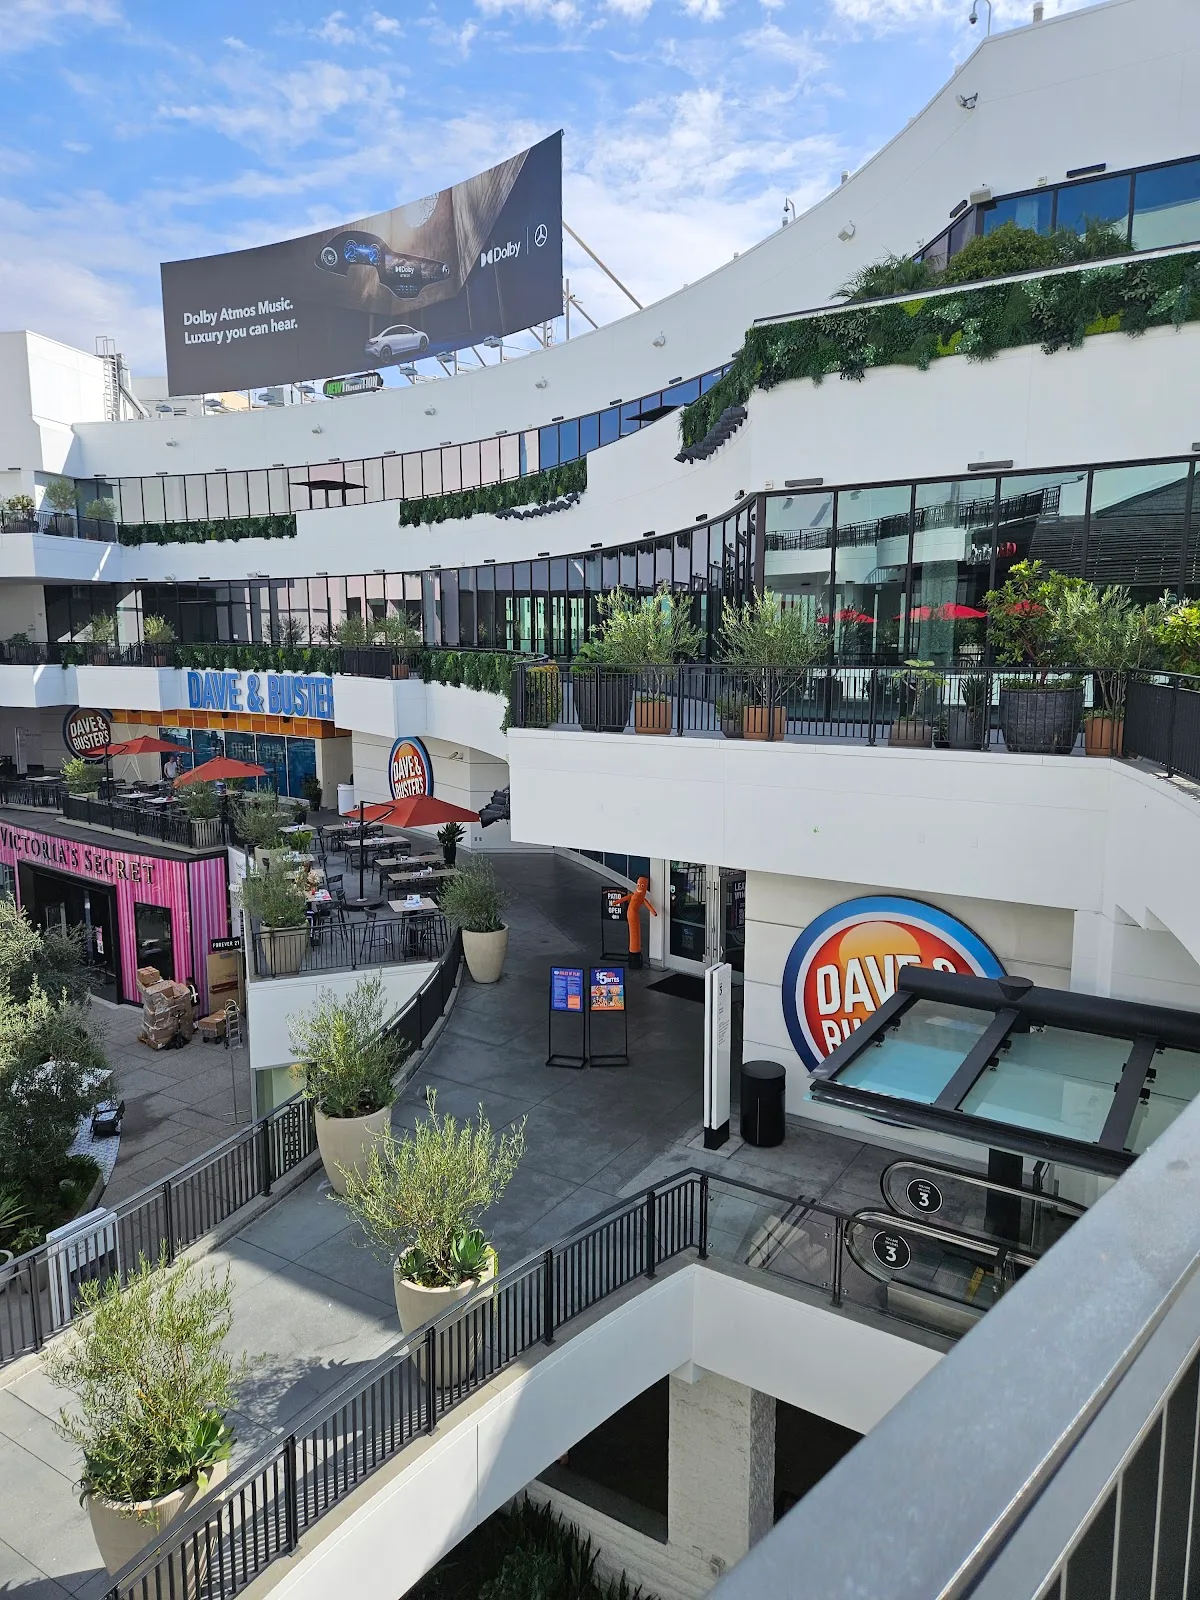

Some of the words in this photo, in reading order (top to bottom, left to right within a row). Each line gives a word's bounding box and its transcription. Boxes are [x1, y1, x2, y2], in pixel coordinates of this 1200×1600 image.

[494, 241, 522, 263] Dolby
[183, 310, 218, 326] Dolby
[219, 306, 256, 322] Atmos
[257, 296, 294, 315] Music.
[184, 330, 224, 345] Luxury
[225, 326, 247, 343] you
[248, 322, 269, 336] can
[270, 318, 299, 333] hear.
[326, 381, 343, 395] NEW
[187, 671, 243, 711] DAVE
[246, 673, 265, 713] &
[70, 716, 99, 738] DAVE
[96, 716, 107, 731] &
[72, 729, 110, 751] BUSTER'S
[393, 755, 416, 783] DAVE
[413, 755, 423, 776] &
[0, 827, 78, 867] VICTORIA'S
[84, 849, 155, 885] SECRET
[607, 892, 622, 900] PATIO
[608, 907, 622, 915] OPEN
[212, 941, 233, 949] FOREVER
[918, 1191, 929, 1206] 3
[885, 1246, 897, 1261] 3
